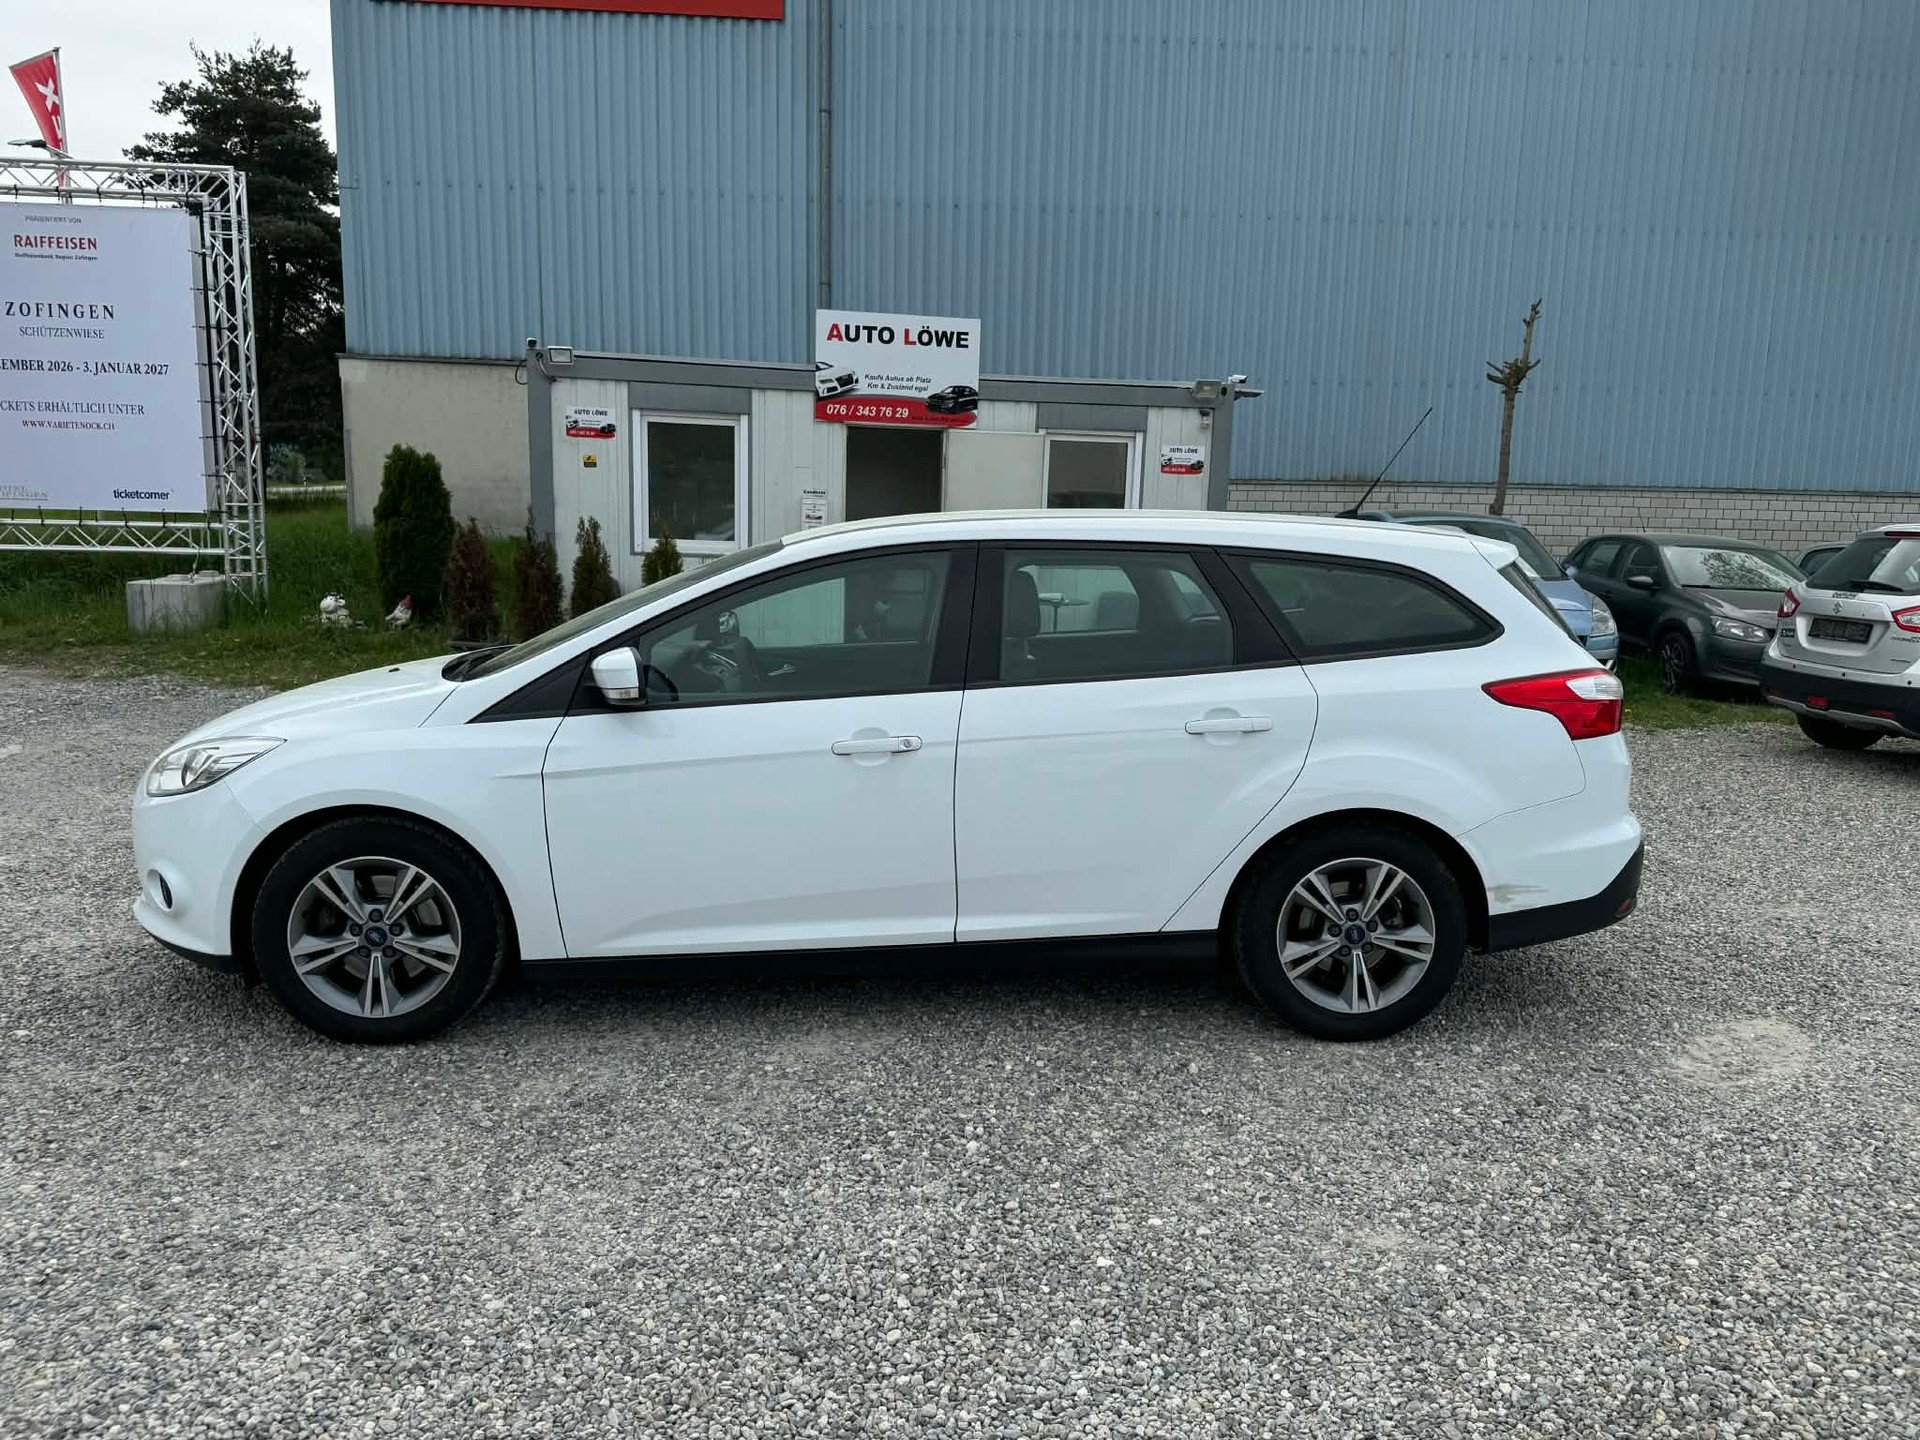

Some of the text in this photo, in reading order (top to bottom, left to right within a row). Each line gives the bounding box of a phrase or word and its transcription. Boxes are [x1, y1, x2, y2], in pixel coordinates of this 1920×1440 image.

[14, 234, 97, 250] RAIFFEISEN
[5, 301, 114, 319] ZOFINGEN
[19, 325, 105, 339] SCHÜTZENWIESE
[827, 323, 969, 348] AUTO LÖWE
[0, 358, 44, 371] EMBER
[47, 360, 73, 372] 2026
[93, 362, 141, 375] JANUAR
[144, 364, 169, 375] 2027
[887, 383, 913, 391] Zustand
[38, 400, 105, 413] ERHÄLTLICH
[108, 403, 145, 415] UNTER
[826, 404, 909, 418] 076 / 343 76 29
[113, 489, 170, 500] ticketcorner
